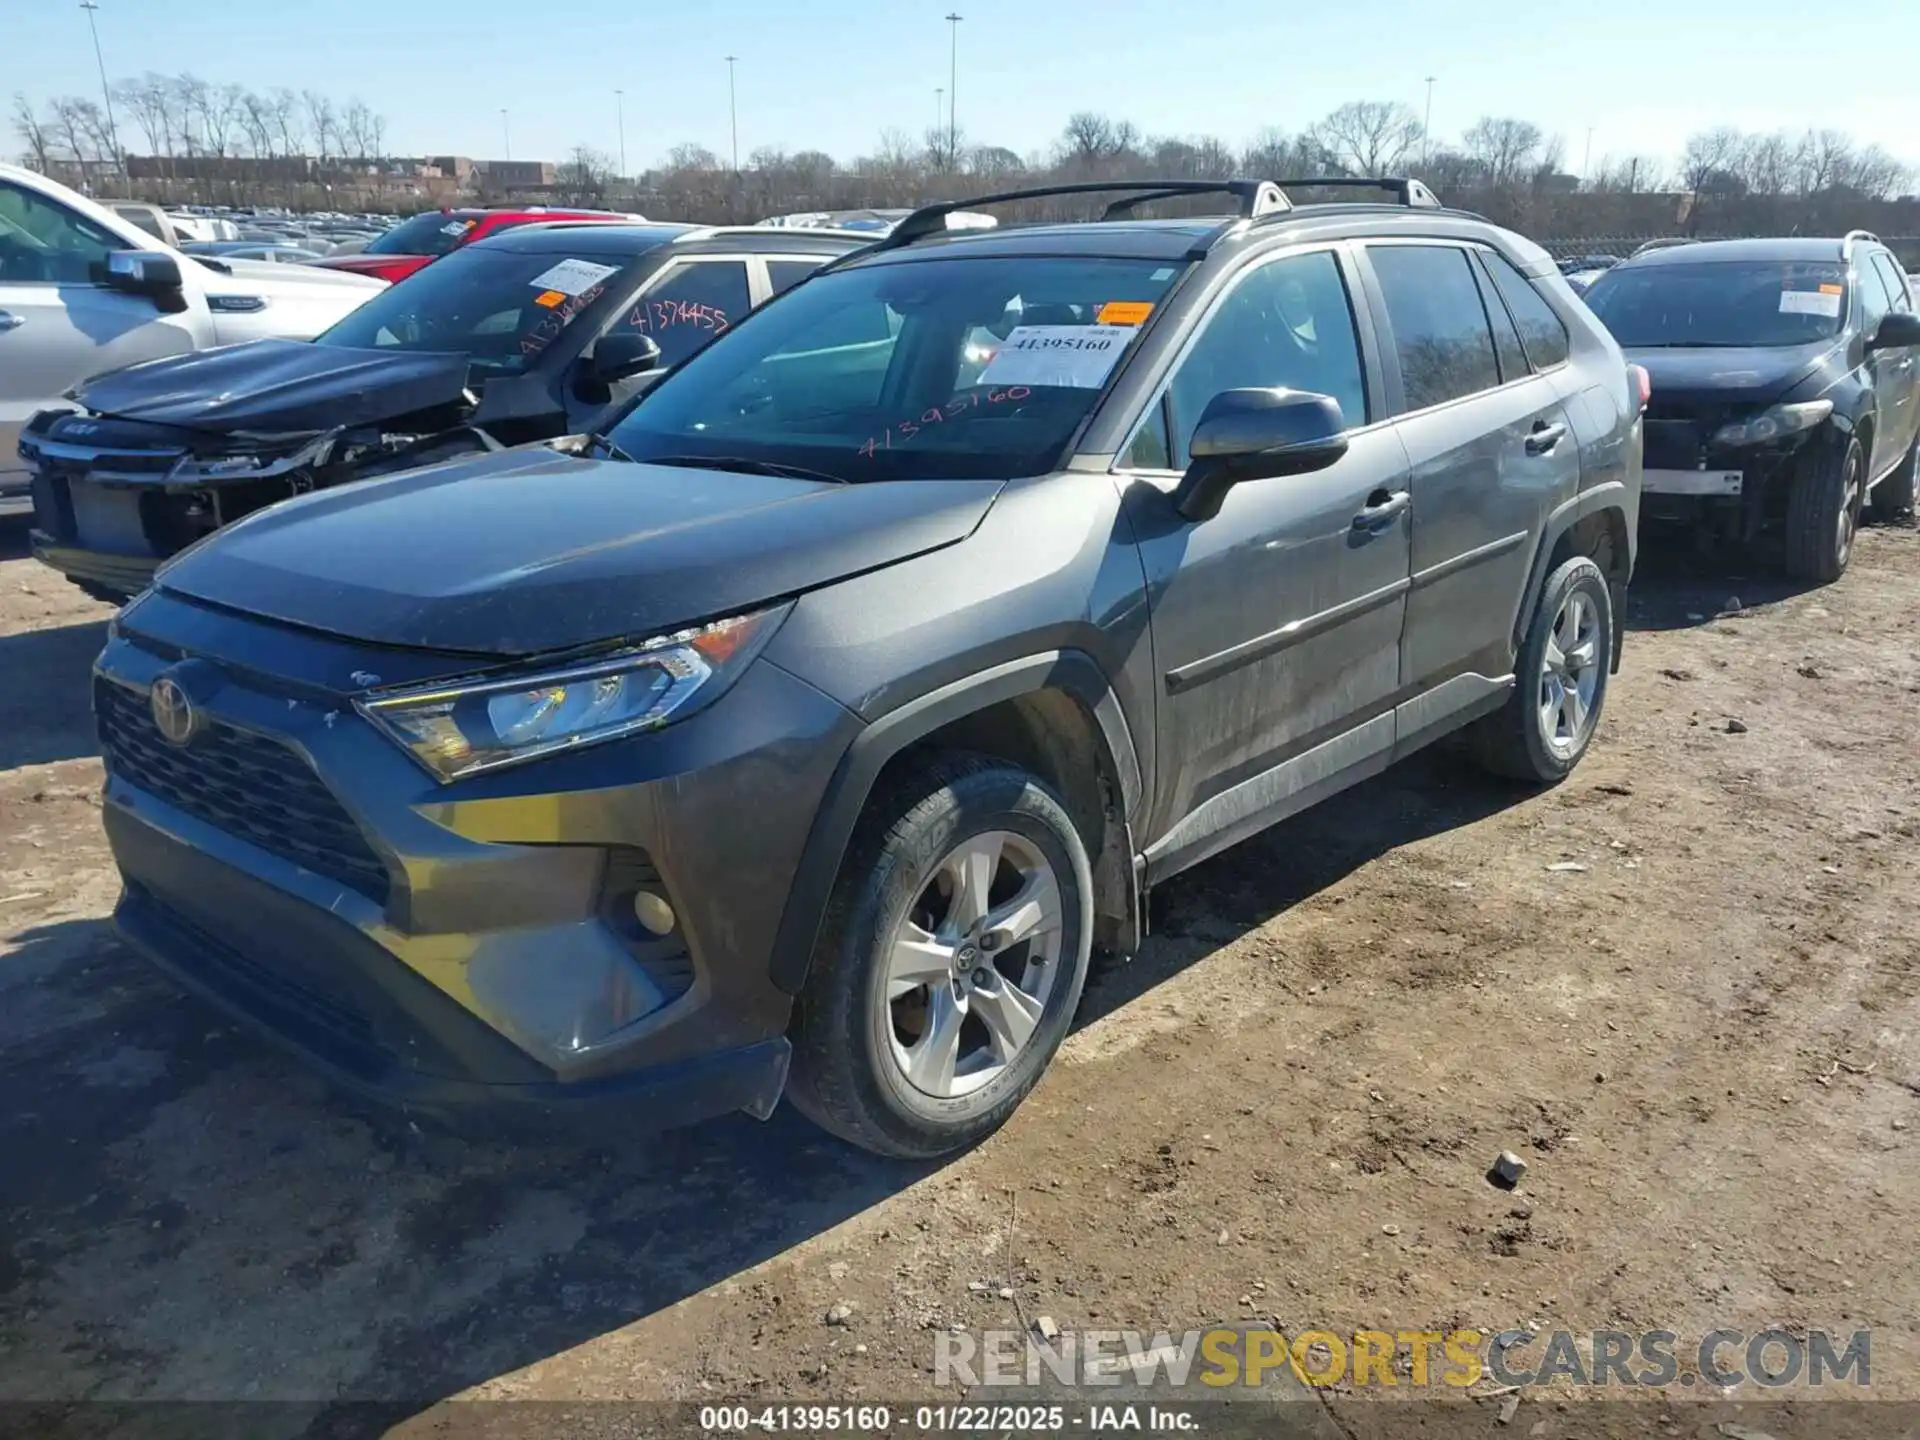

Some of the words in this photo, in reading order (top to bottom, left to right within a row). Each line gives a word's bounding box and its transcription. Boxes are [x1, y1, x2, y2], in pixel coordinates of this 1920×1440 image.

[629, 299, 729, 334] 41374455
[1013, 337, 1112, 351] 41395160
[858, 386, 1031, 459] 41395160
